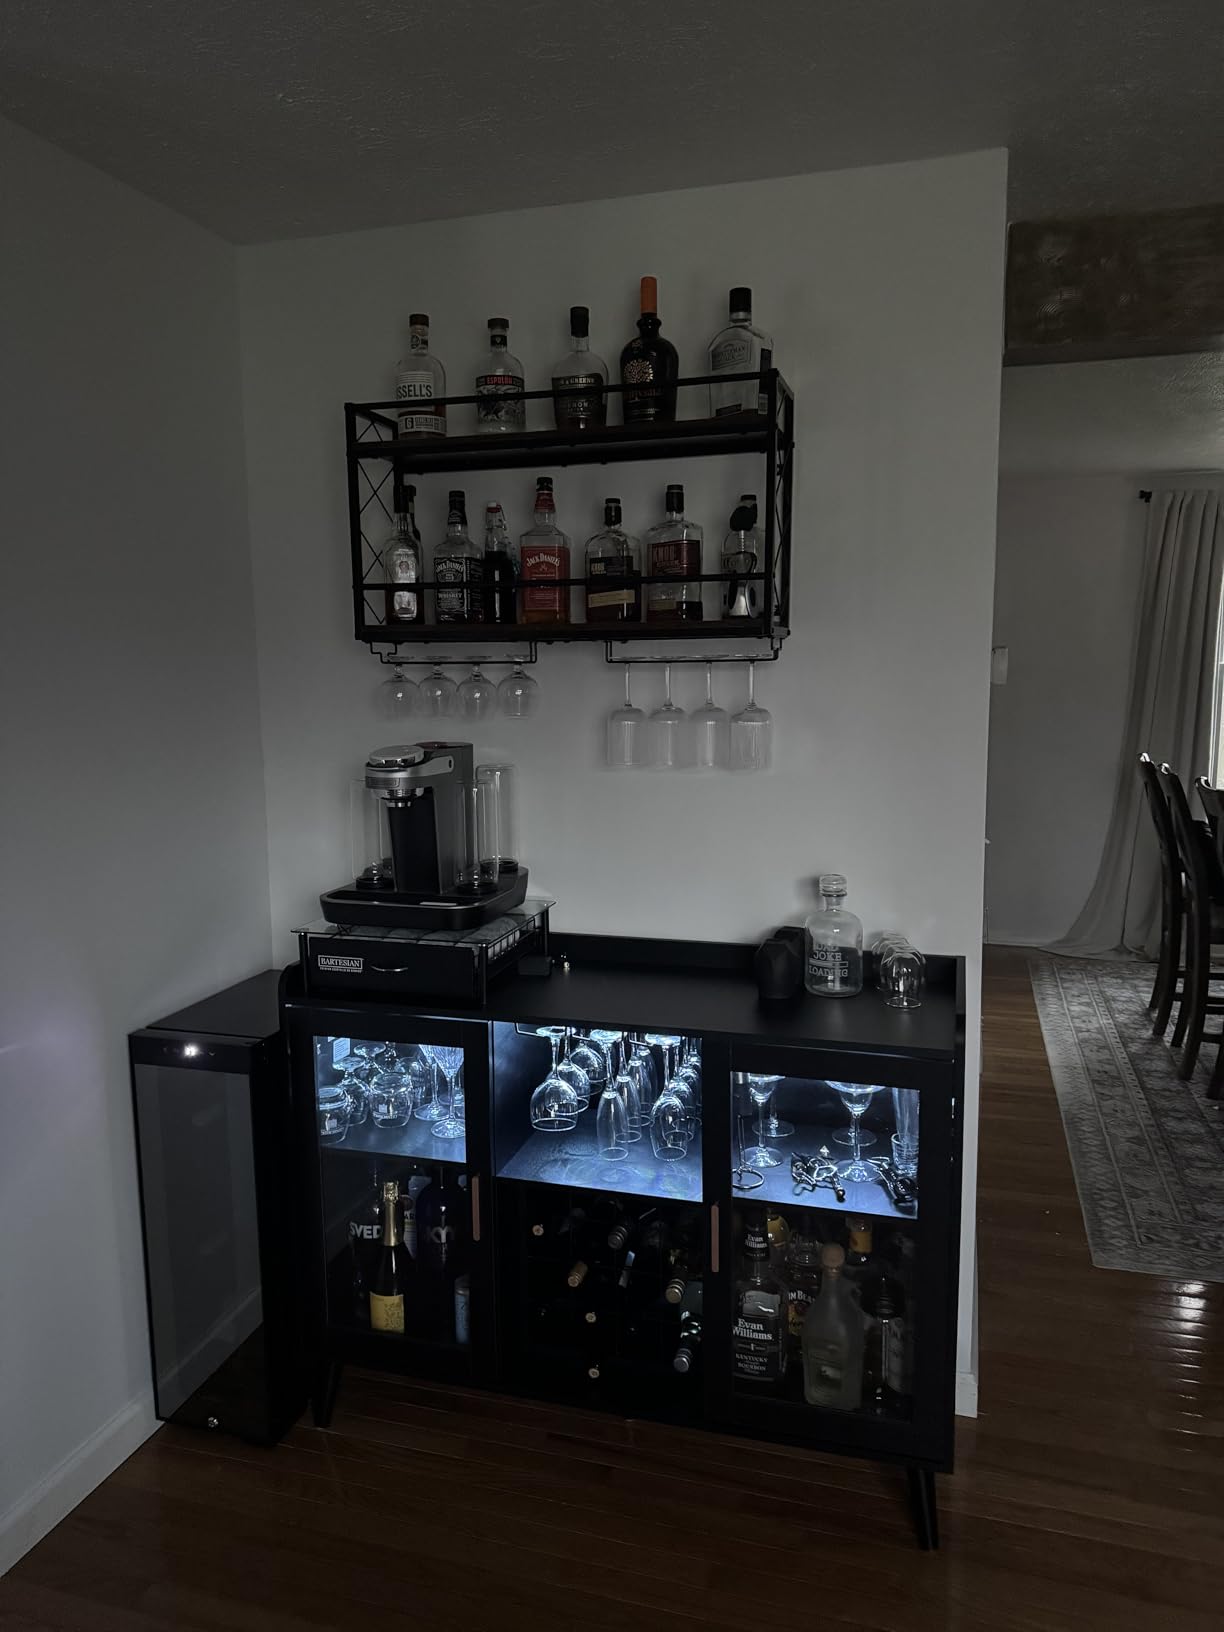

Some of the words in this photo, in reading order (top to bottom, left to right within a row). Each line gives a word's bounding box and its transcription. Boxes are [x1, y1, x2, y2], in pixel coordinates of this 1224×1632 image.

[527, 556, 541, 568] JACK
[540, 553, 561, 567] DANIEL'S
[813, 951, 842, 961] JOKE
[320, 957, 360, 967] BARTESIAN
[747, 1233, 764, 1242] Evan
[737, 1318, 764, 1331] Evan
[732, 1326, 775, 1341] Williams
[735, 1353, 768, 1363] KENTUCKY
